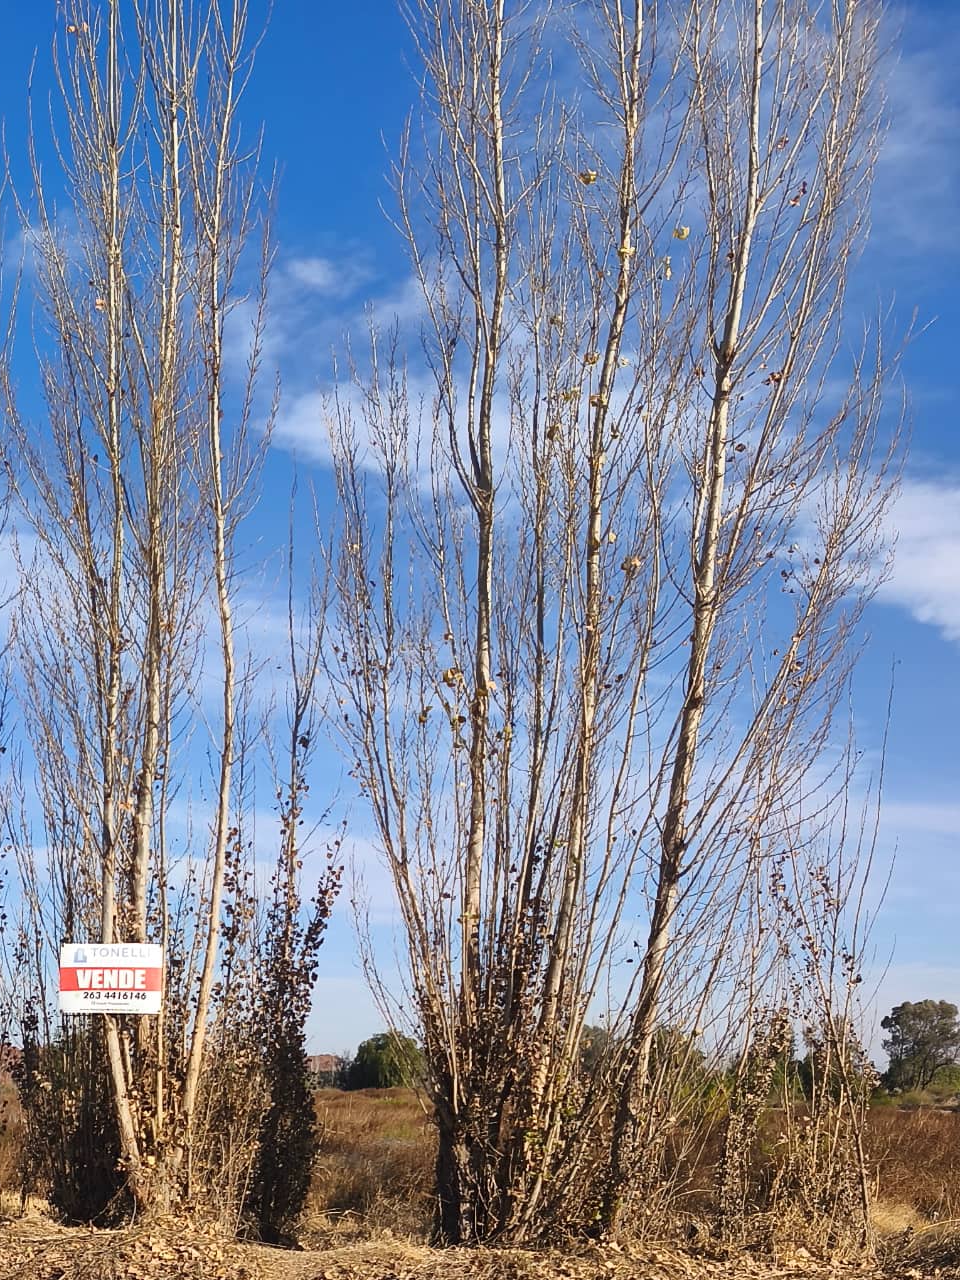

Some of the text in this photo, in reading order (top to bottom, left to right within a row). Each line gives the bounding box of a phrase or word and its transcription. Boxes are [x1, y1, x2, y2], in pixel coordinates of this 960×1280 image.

[90, 947, 150, 958] TONELLI
[76, 969, 147, 989] VENDE
[83, 991, 147, 1000] 263 4416146
